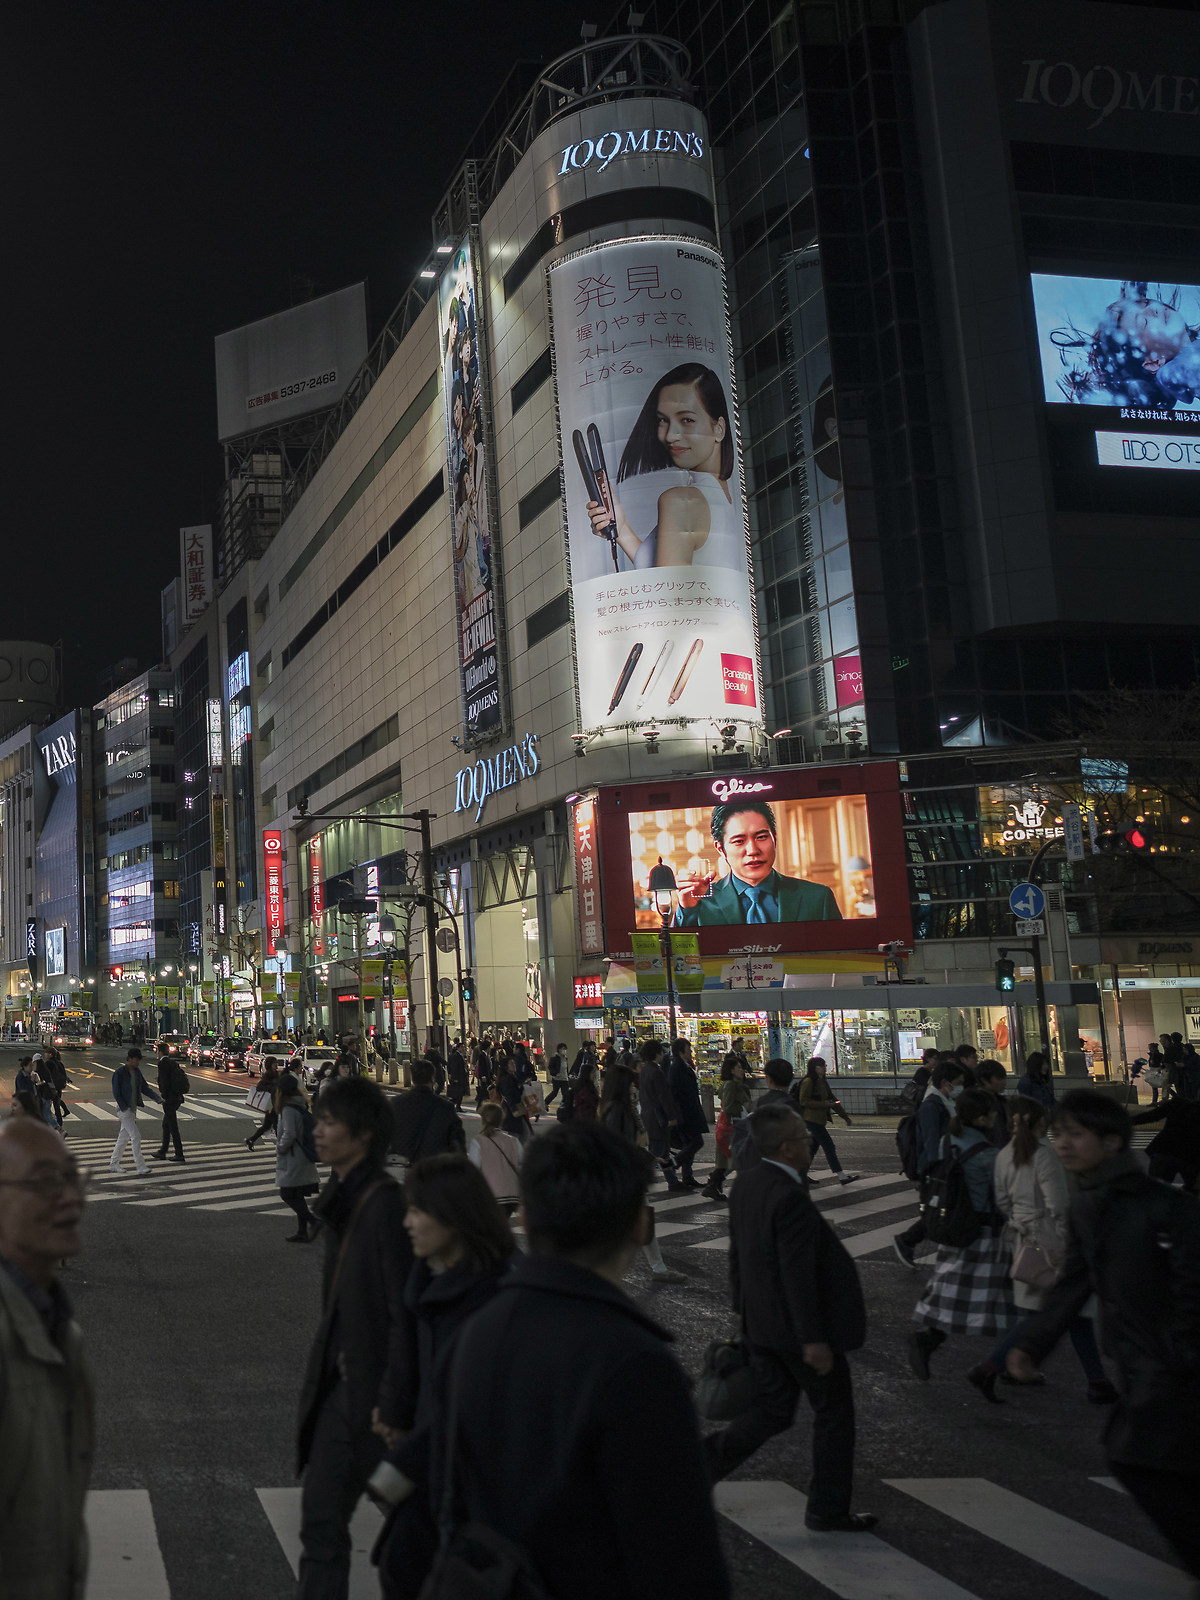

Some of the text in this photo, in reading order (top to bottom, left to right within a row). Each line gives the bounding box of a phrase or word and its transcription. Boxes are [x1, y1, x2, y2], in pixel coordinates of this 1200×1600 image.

[558, 129, 703, 176] 109MEN'S
[677, 249, 719, 270] Panasonic
[574, 265, 683, 317] 発見。
[576, 310, 693, 343] 握りやすさで、
[578, 333, 717, 364] ストレート性能は
[280, 371, 336, 398] 5337-2468
[579, 360, 644, 388] 上がる。
[186, 533, 206, 601] 大和証券
[595, 581, 711, 602] 手になじむグリップで、
[597, 597, 741, 618] 髪の根元から、まっすぐ美しく。
[598, 628, 613, 637] New
[613, 619, 670, 633] ストレートアイロン
[672, 618, 701, 626] ナノケア
[723, 667, 754, 682] Panasonic
[724, 680, 748, 694] Beauty
[468, 690, 499, 722] 109MEN'S
[41, 731, 76, 777] ZARA
[453, 732, 538, 823] 109MEN'S
[711, 780, 774, 802] Glico
[1002, 827, 1065, 841] COFFEE
[1069, 809, 1081, 856] 渋谷駅前
[578, 825, 599, 950] 天津甘栗
[26, 923, 36, 956] ZARA
[50, 993, 66, 1007] ZARA
[574, 982, 602, 999] 天津甘栗
